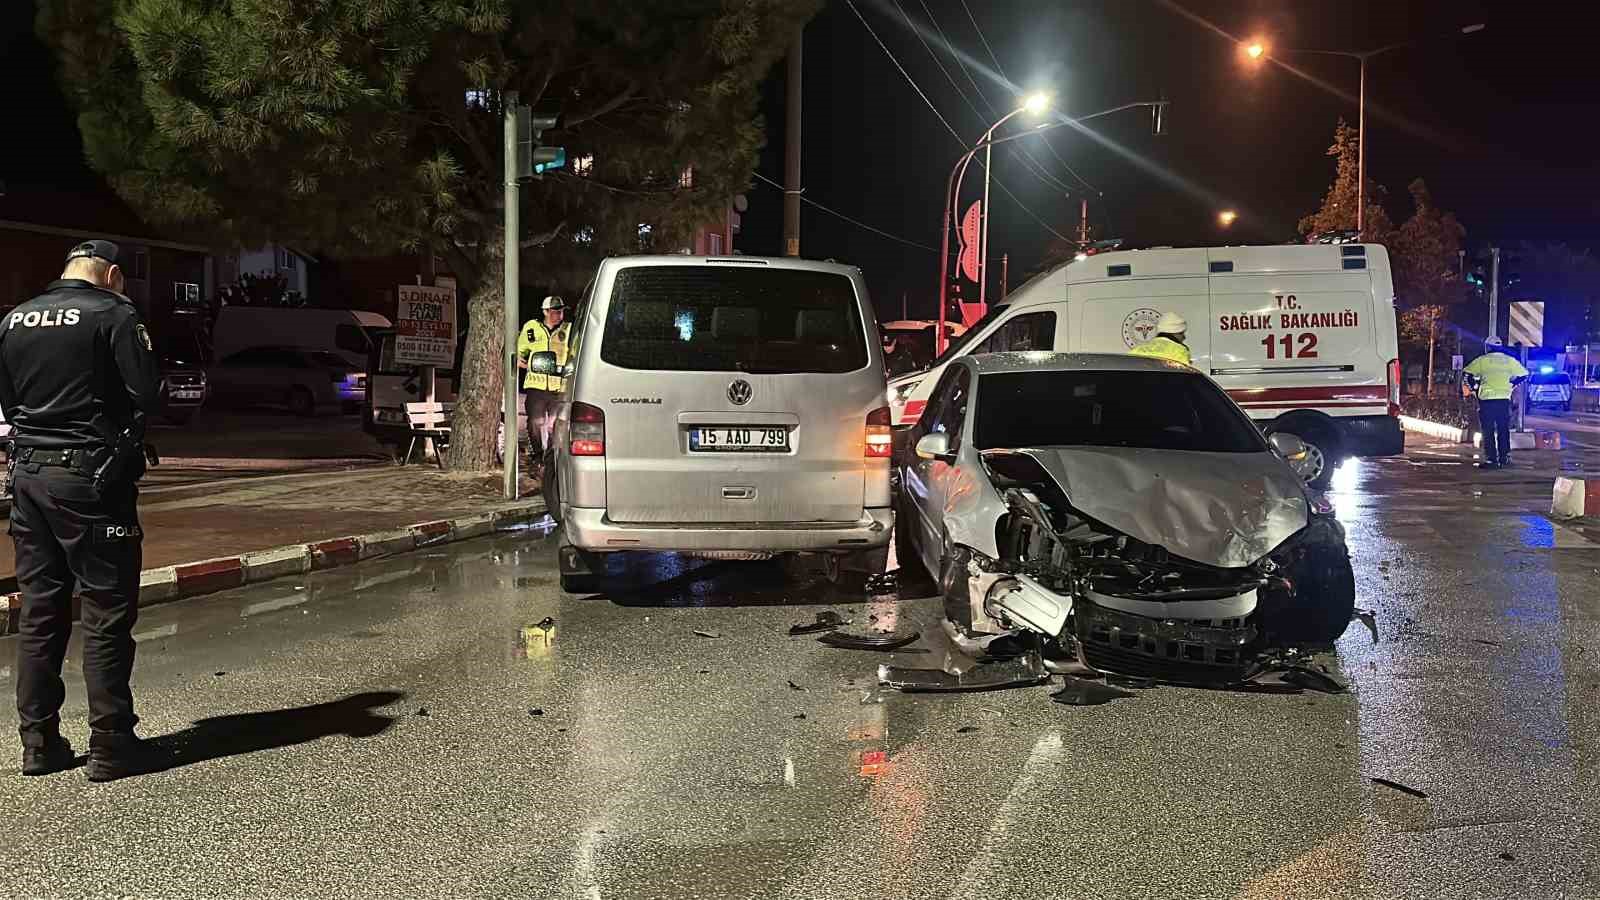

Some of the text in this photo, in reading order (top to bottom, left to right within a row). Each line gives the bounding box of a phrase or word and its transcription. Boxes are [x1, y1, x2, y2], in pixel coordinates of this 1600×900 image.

[1275, 295, 1302, 310] T.C.
[1219, 309, 1358, 331] SAĞLIK BAKANLIĞI
[1261, 332, 1319, 359] 112
[702, 429, 784, 444] 15 AAD 799
